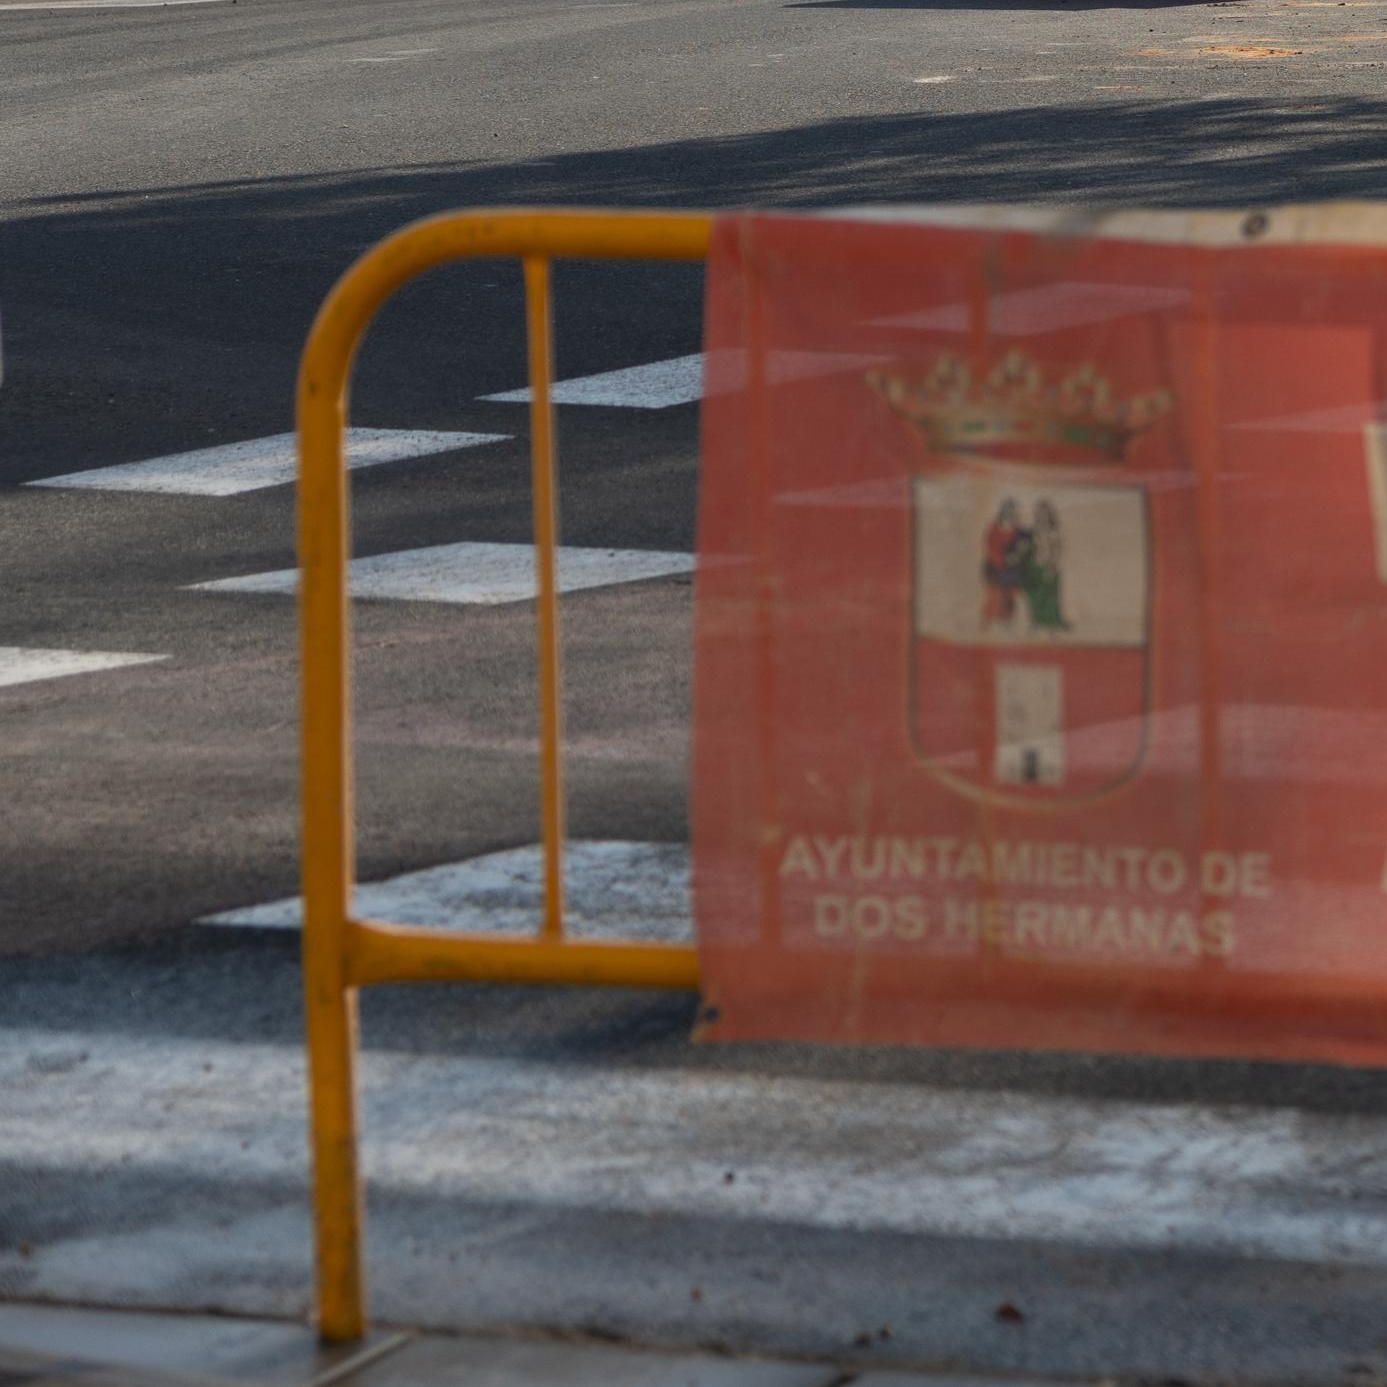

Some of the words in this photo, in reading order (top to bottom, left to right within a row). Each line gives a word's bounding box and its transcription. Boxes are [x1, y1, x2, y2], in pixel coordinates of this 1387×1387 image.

[778, 833, 1186, 895] AYUNTAMIENTO
[1202, 849, 1272, 899] DE
[813, 893, 927, 941] DOS
[944, 898, 1237, 956] HERMANAS
